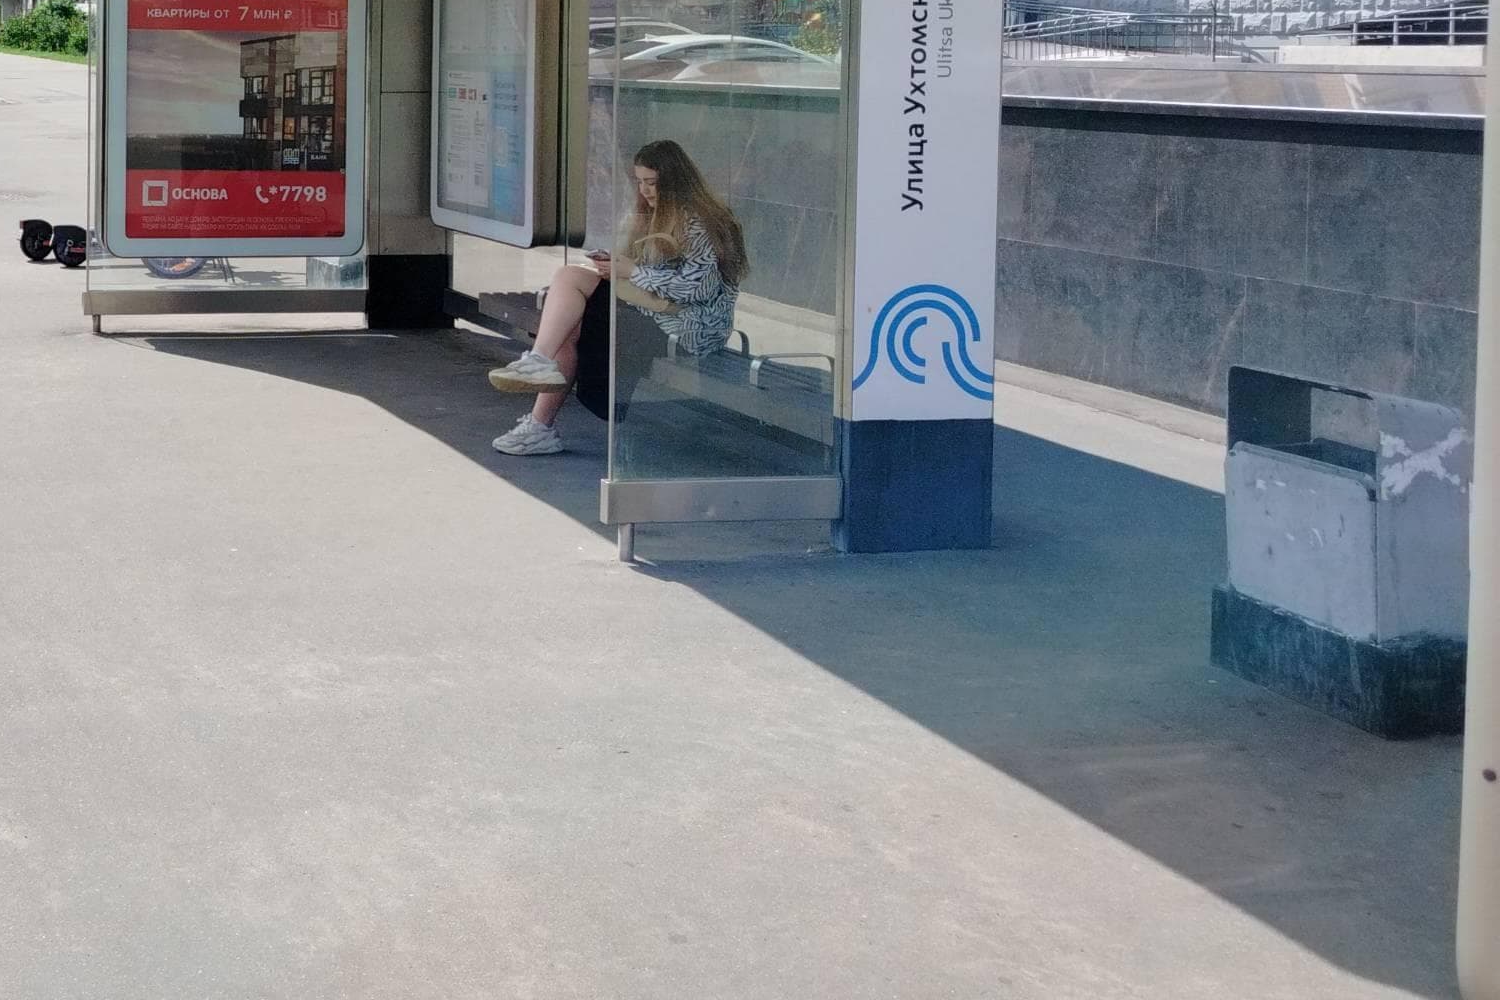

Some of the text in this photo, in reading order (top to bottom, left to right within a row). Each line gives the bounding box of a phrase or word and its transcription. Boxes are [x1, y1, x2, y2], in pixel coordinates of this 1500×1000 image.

[147, 8, 210, 19] КВАРТИРЫ
[214, 9, 229, 19] ОТ
[238, 6, 249, 21] 7
[253, 10, 280, 20] МЛН
[936, 25, 953, 79] Ulitsa
[901, 122, 925, 211] Улица
[172, 187, 228, 201] ОСНОВА
